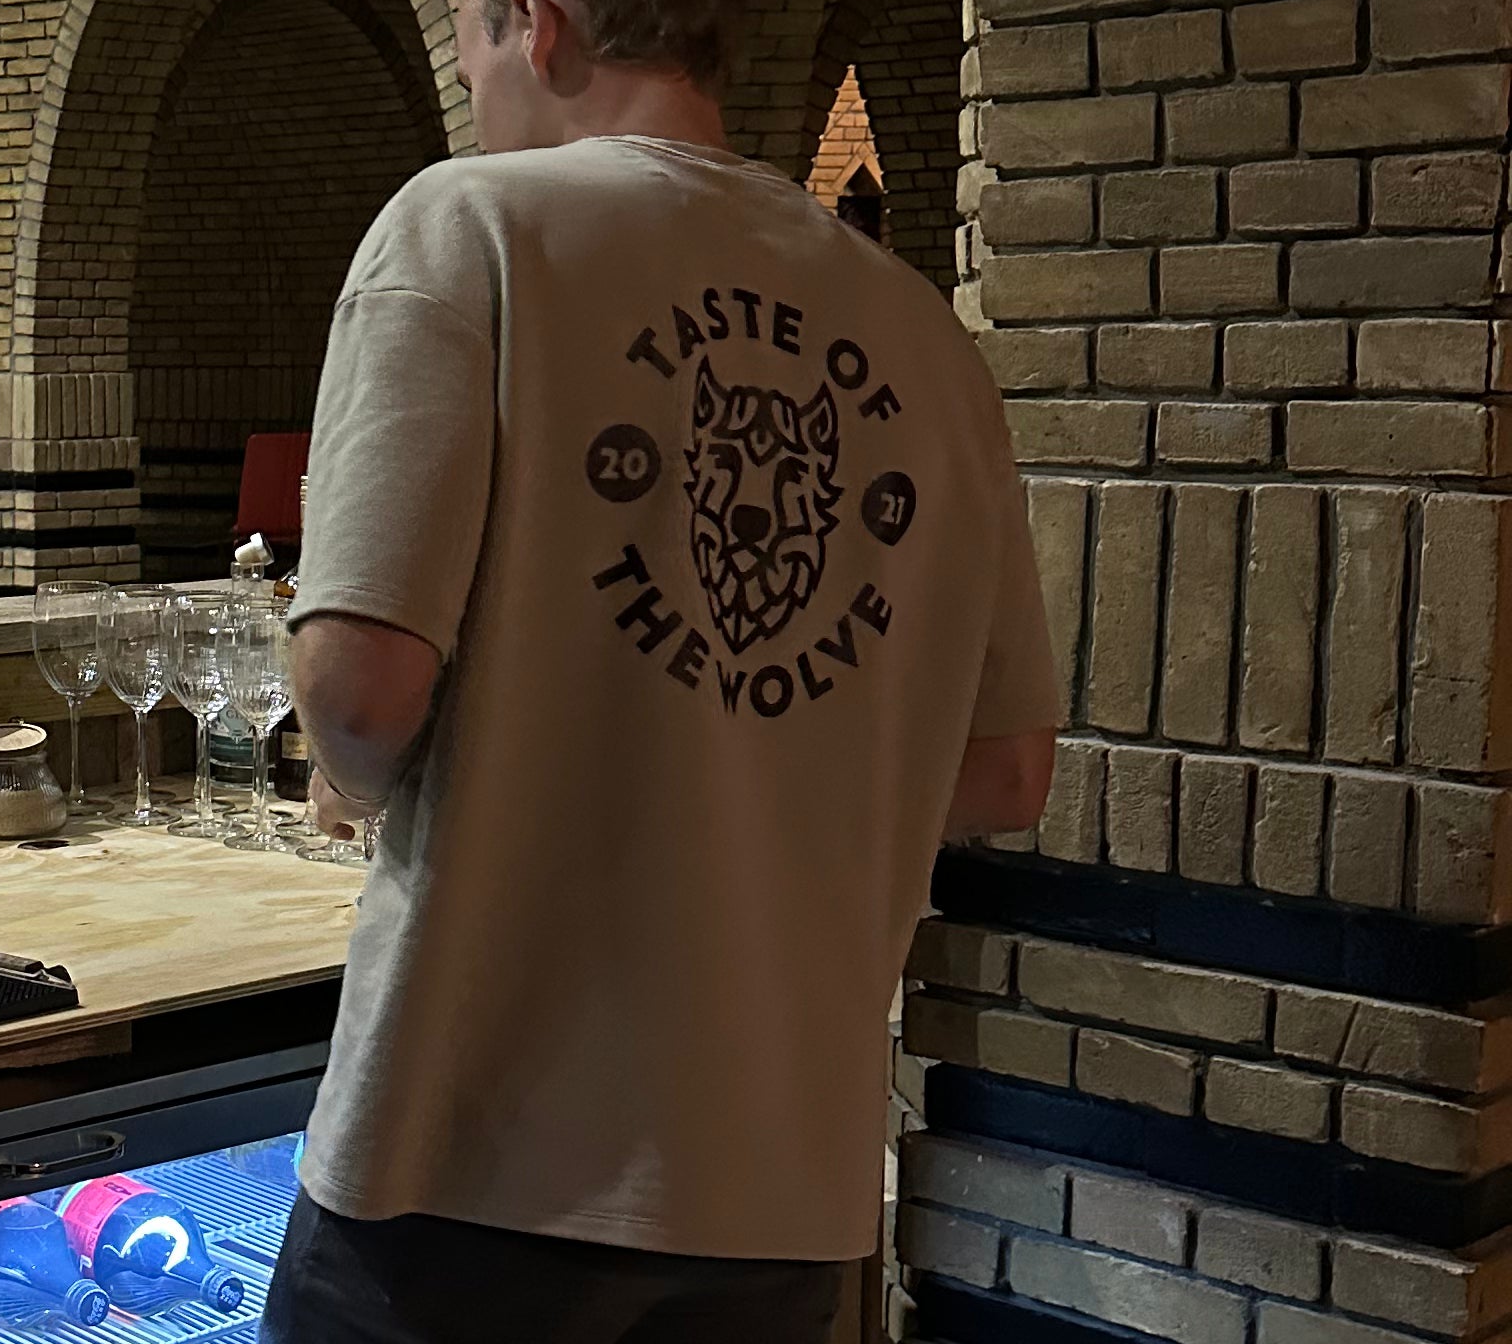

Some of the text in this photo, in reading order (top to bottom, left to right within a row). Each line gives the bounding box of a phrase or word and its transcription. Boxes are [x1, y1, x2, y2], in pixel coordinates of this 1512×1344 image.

[626, 287, 902, 422] TASTE OF
[598, 448, 648, 481] 20
[591, 543, 893, 719] THE WOLVE
